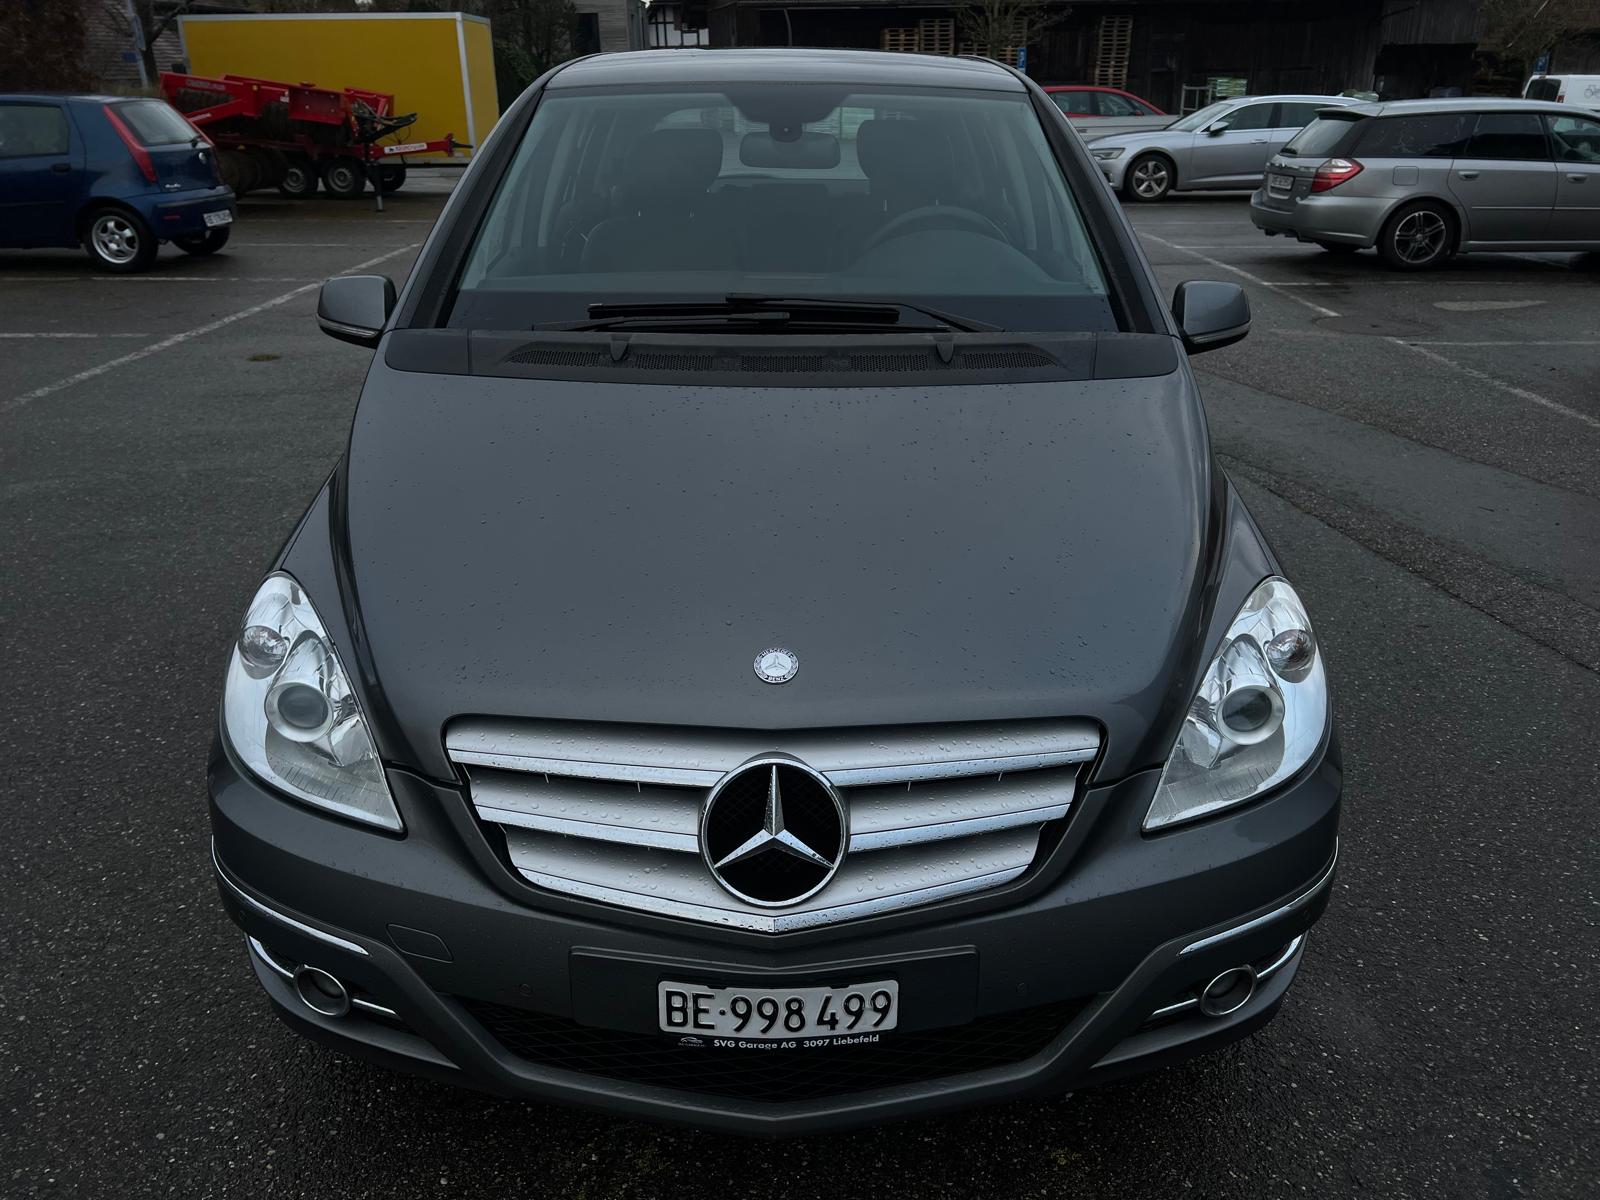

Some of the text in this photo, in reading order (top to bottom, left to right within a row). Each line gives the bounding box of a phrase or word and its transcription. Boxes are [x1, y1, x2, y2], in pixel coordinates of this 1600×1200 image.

[816, 990, 892, 1031] 499
[714, 1039, 735, 1048] SVG
[739, 1040, 778, 1050] Garage
[781, 1041, 797, 1049] AG
[803, 1039, 830, 1048] 3097
[833, 1034, 879, 1046] Liebefeld
